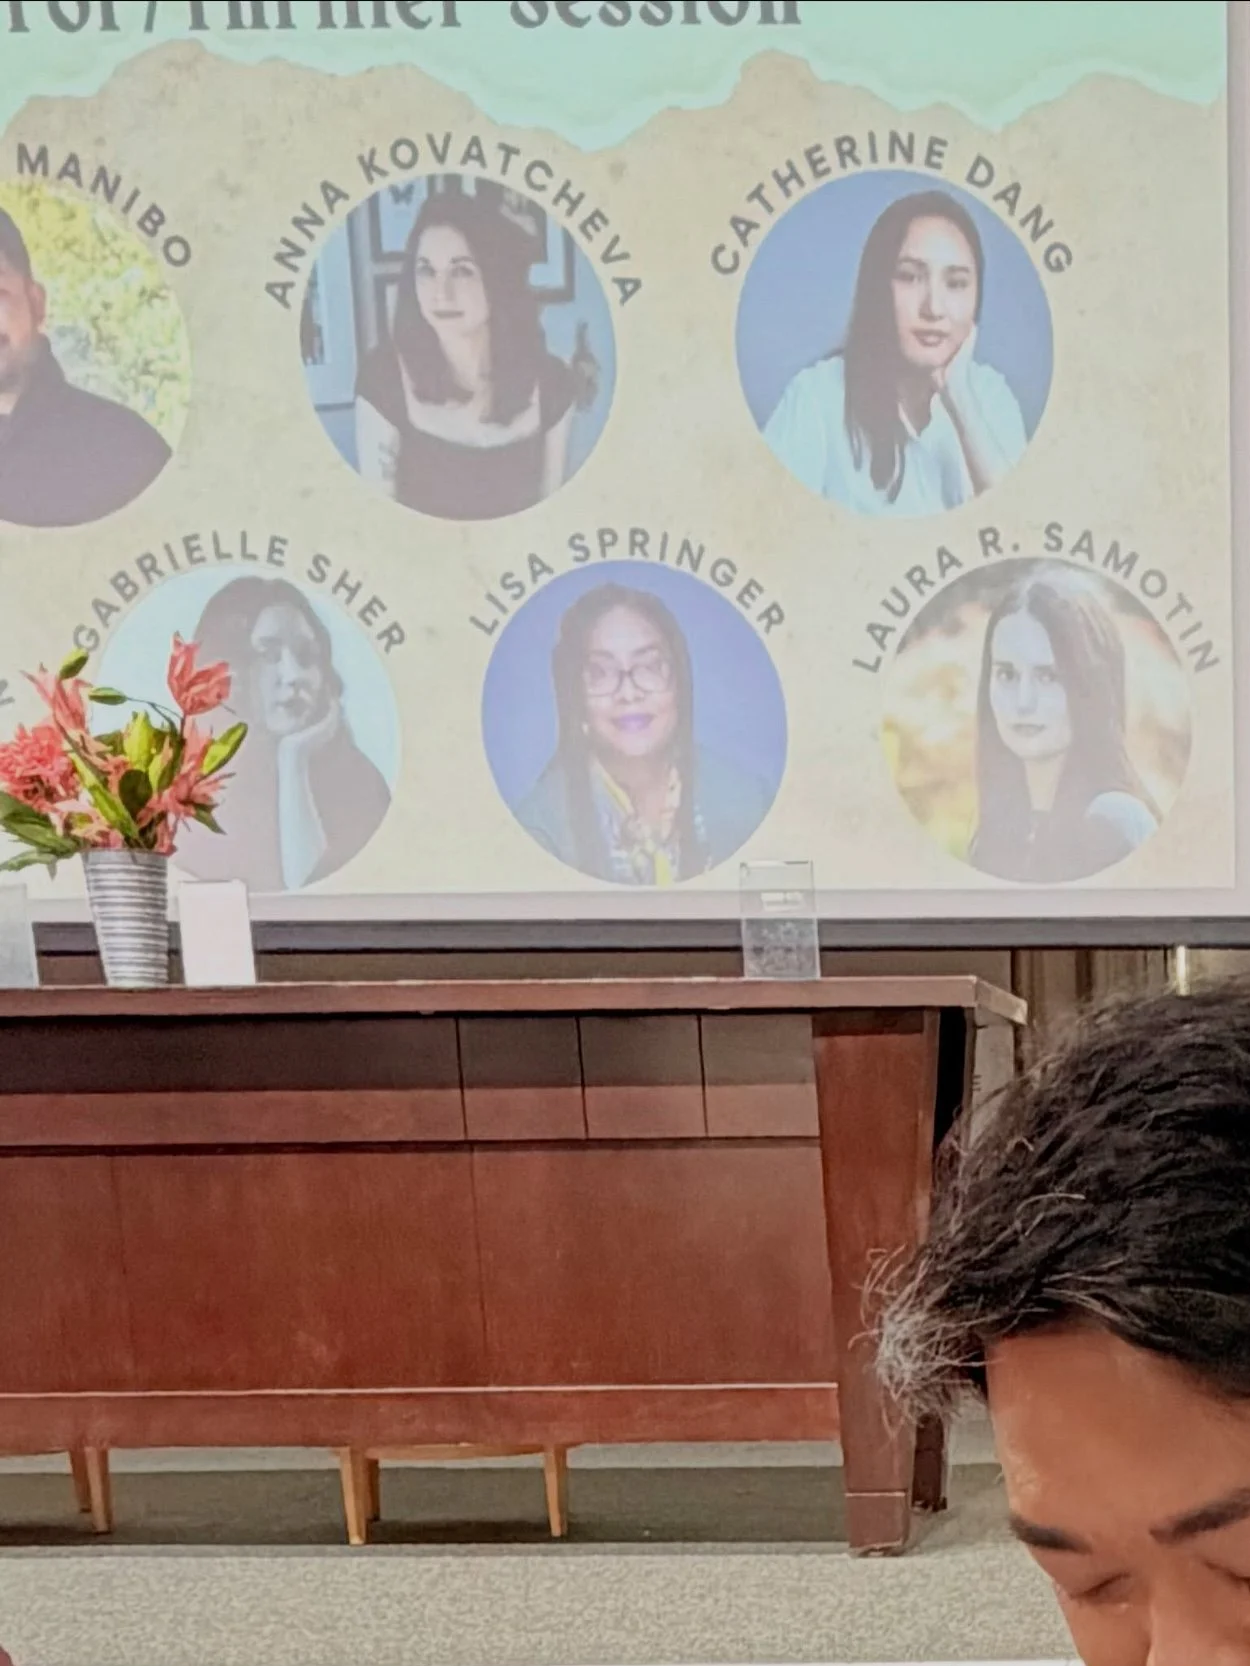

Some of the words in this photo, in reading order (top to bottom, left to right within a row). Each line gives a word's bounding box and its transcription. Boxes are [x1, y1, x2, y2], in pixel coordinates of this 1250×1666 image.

[16, 142, 192, 268] MANIBO
[264, 178, 350, 310] ANNA
[358, 131, 644, 306] KOVATCHEVA
[710, 129, 949, 276] CATHERINE
[964, 152, 1074, 274] DANG
[72, 530, 290, 654] GABRIELLE
[306, 553, 407, 655] SHER
[468, 552, 555, 636] LISA
[567, 527, 786, 634] SPRINGER
[851, 545, 965, 674] LAURA
[977, 525, 1020, 558] R.
[1043, 521, 1221, 674] SAMOTIN
